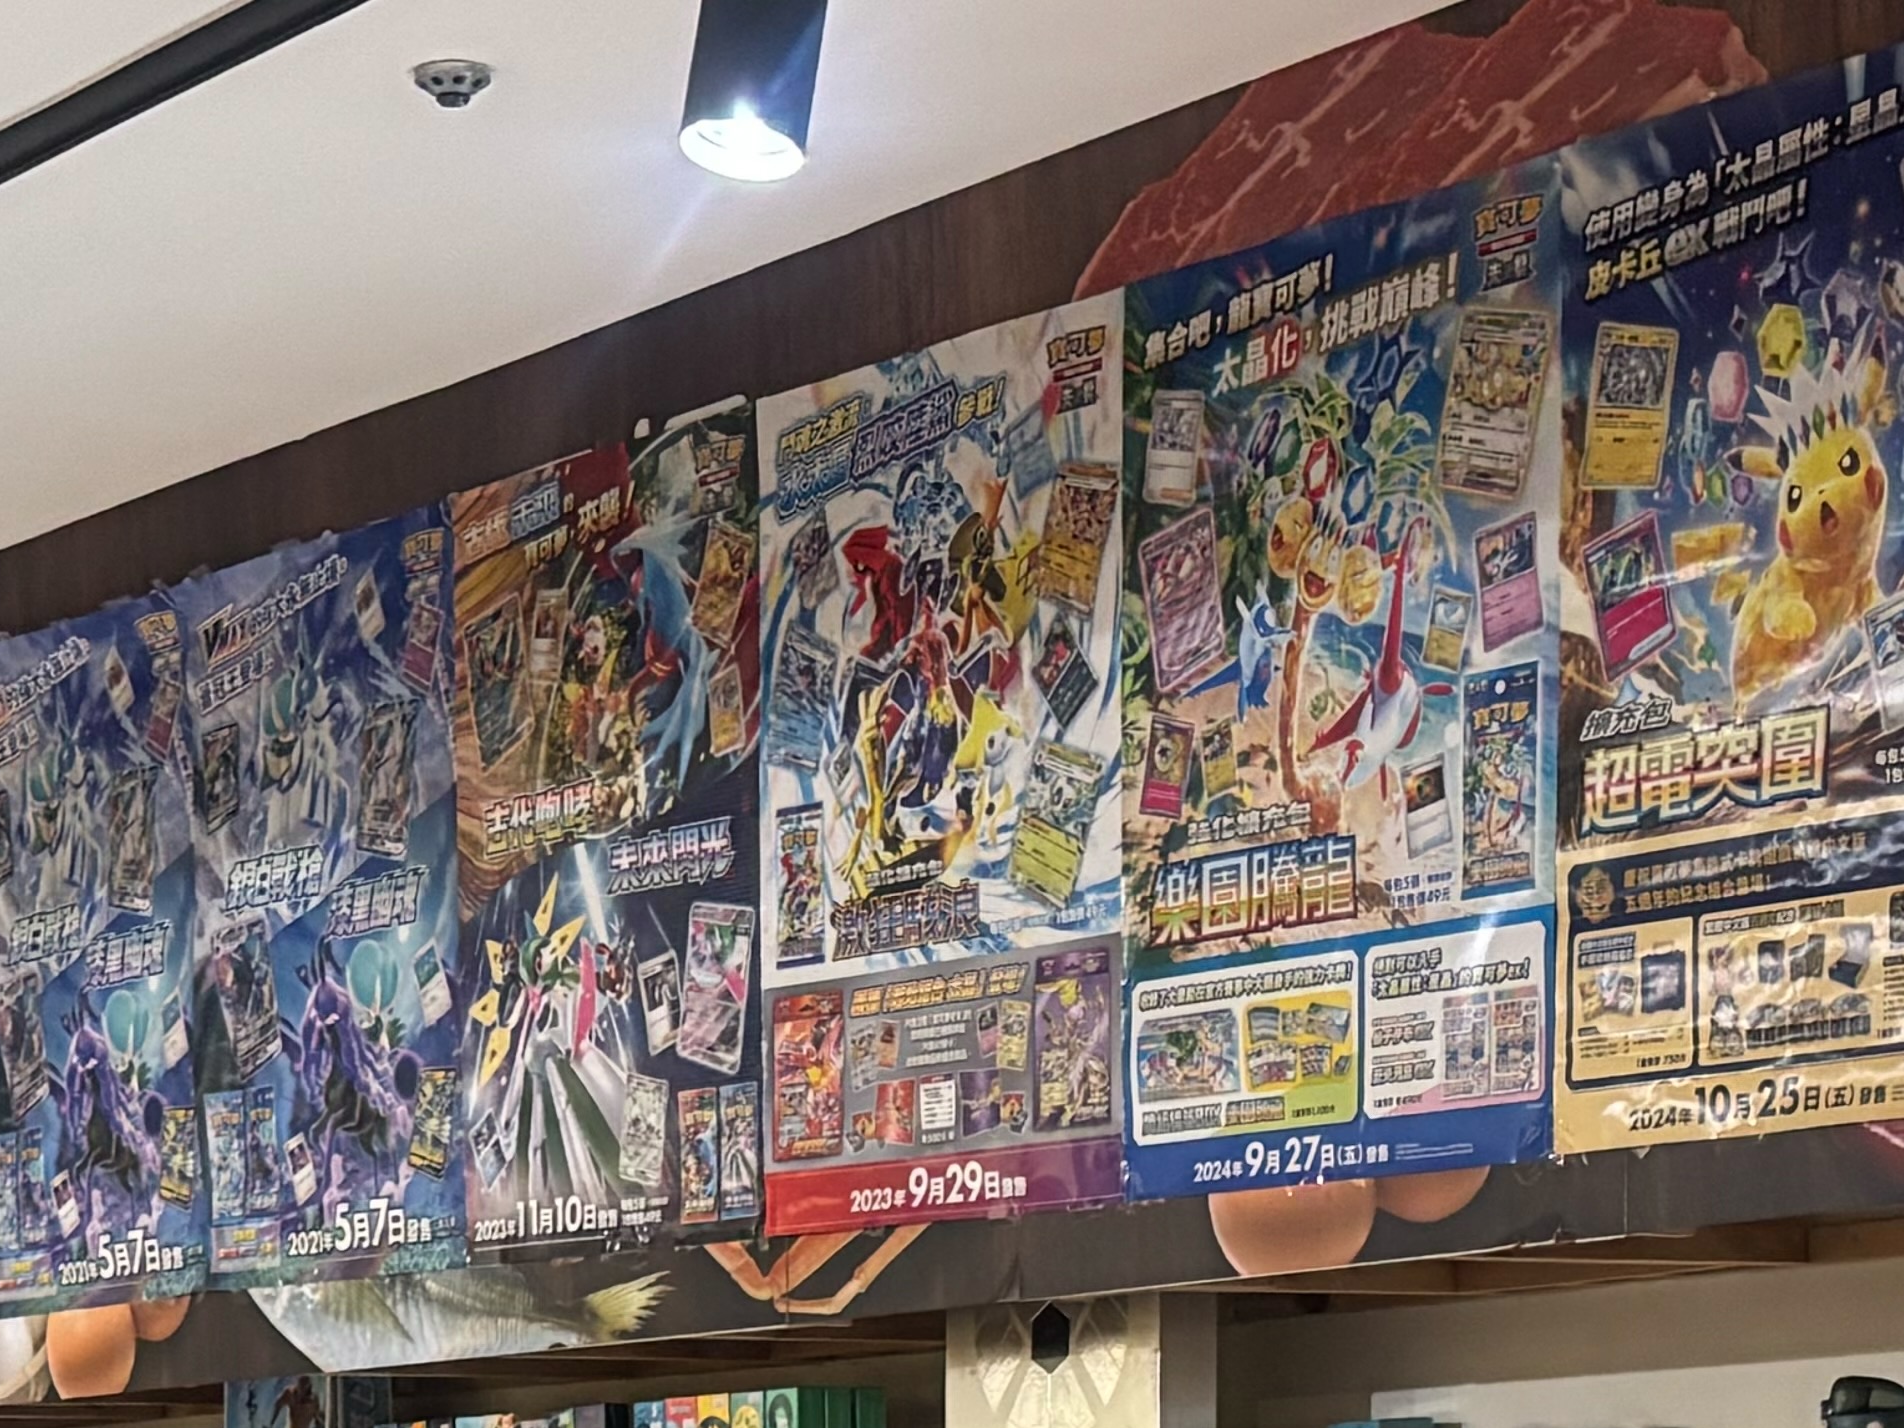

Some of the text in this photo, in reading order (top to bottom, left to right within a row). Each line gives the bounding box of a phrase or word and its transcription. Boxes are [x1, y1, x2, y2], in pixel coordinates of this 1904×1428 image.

[1581, 705, 1828, 836] 超電突圍
[1149, 835, 1358, 948] 樂園騰龍
[849, 1160, 1028, 1213] 2023年9月29日發售
[1194, 1135, 1389, 1183] 2024年9月27日(五)發售
[287, 1198, 433, 1258] 2021年5月7日發售
[58, 1229, 185, 1286] 2021年5月7日發售
